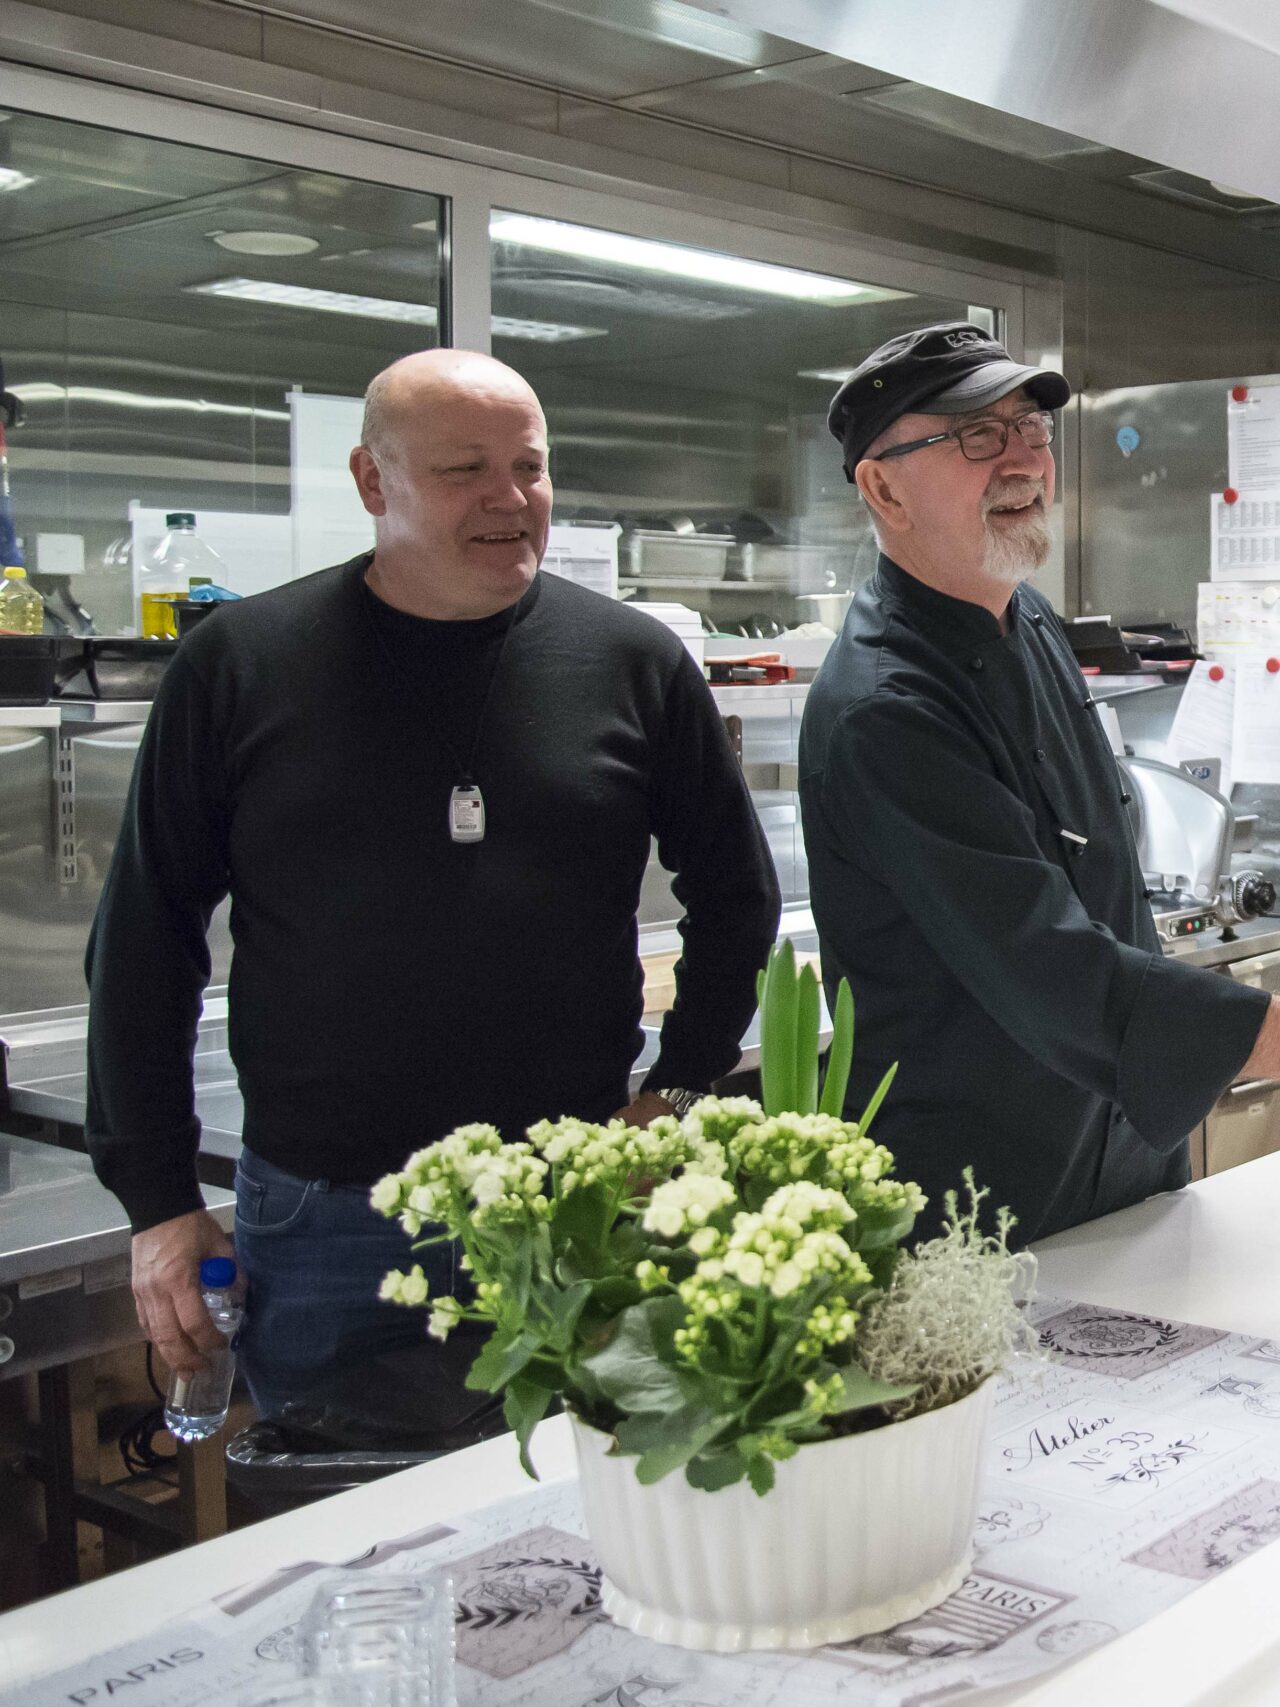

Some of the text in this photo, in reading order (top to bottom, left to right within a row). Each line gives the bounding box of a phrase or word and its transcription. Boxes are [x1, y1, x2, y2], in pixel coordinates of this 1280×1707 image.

[1003, 1415, 1116, 1472] Atelier
[962, 1578, 1048, 1614] PARIS
[67, 1647, 205, 1706] PARIS
